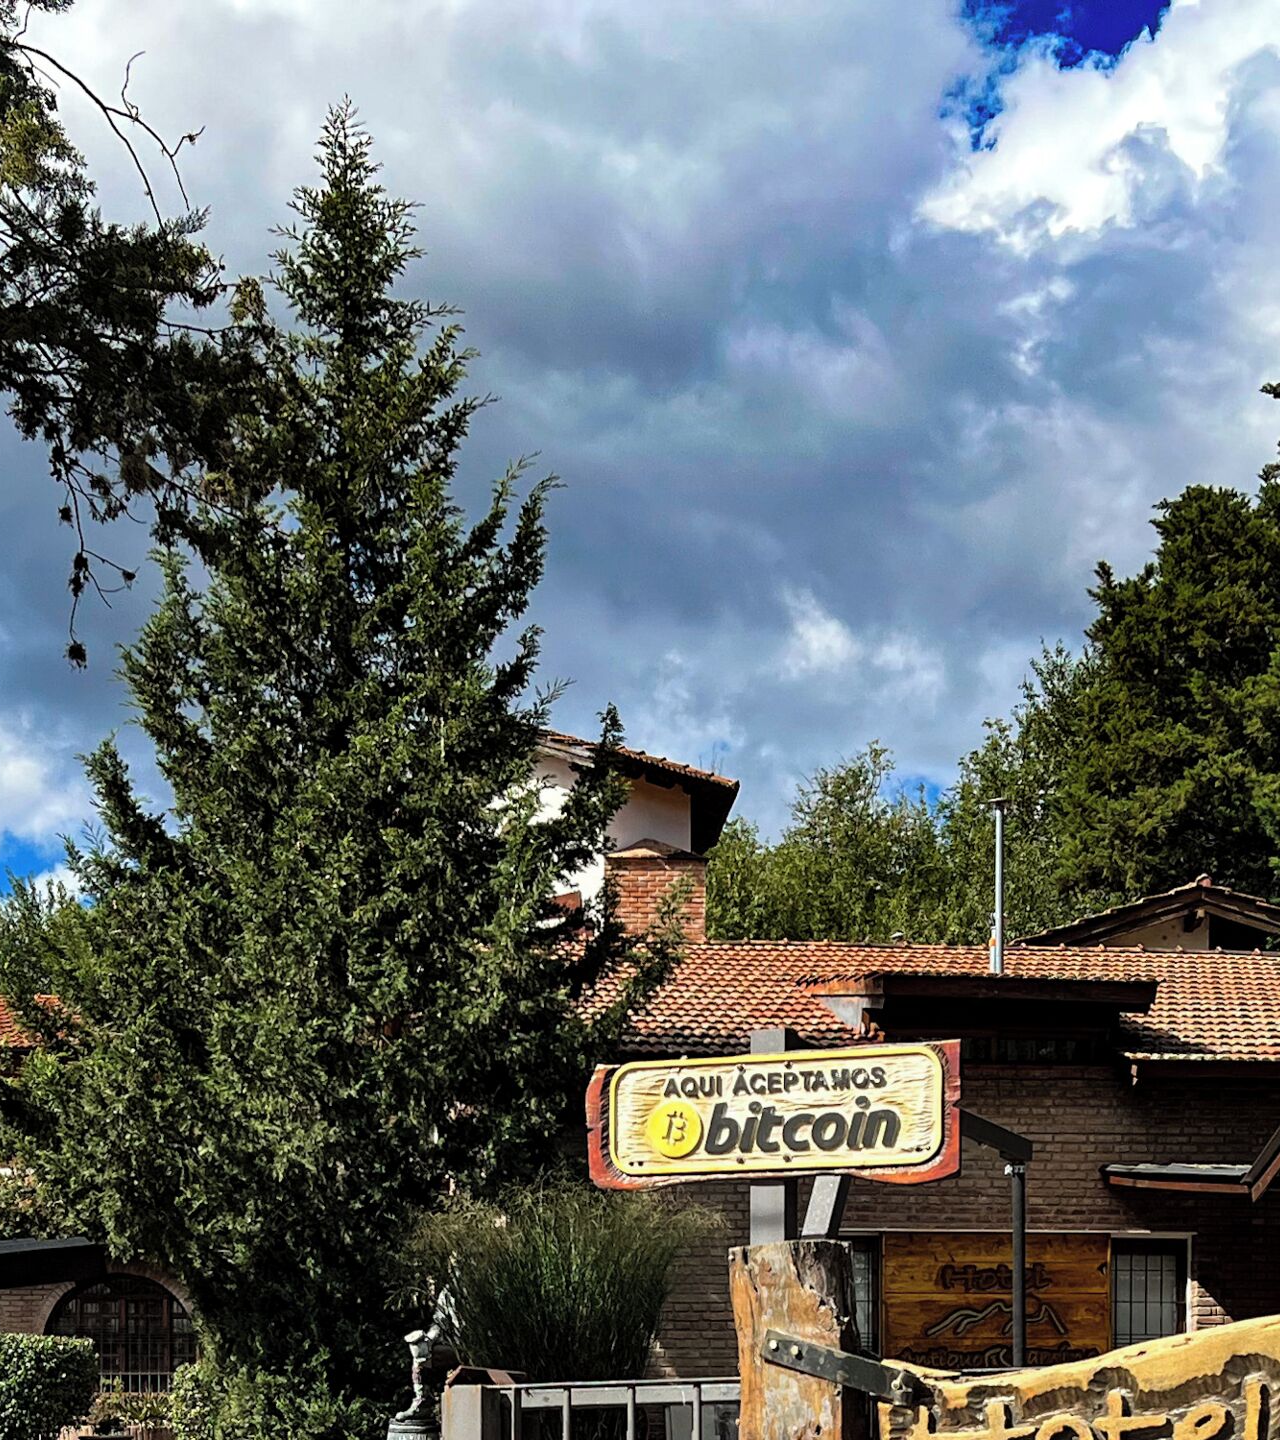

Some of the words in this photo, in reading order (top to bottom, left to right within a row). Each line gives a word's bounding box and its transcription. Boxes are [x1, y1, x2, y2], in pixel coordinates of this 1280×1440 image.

[663, 1076, 723, 1099] AQUI
[732, 1066, 888, 1097] ACEPTAMOS
[704, 1096, 902, 1155] bitcoin
[944, 1263, 1051, 1289] Hotl
